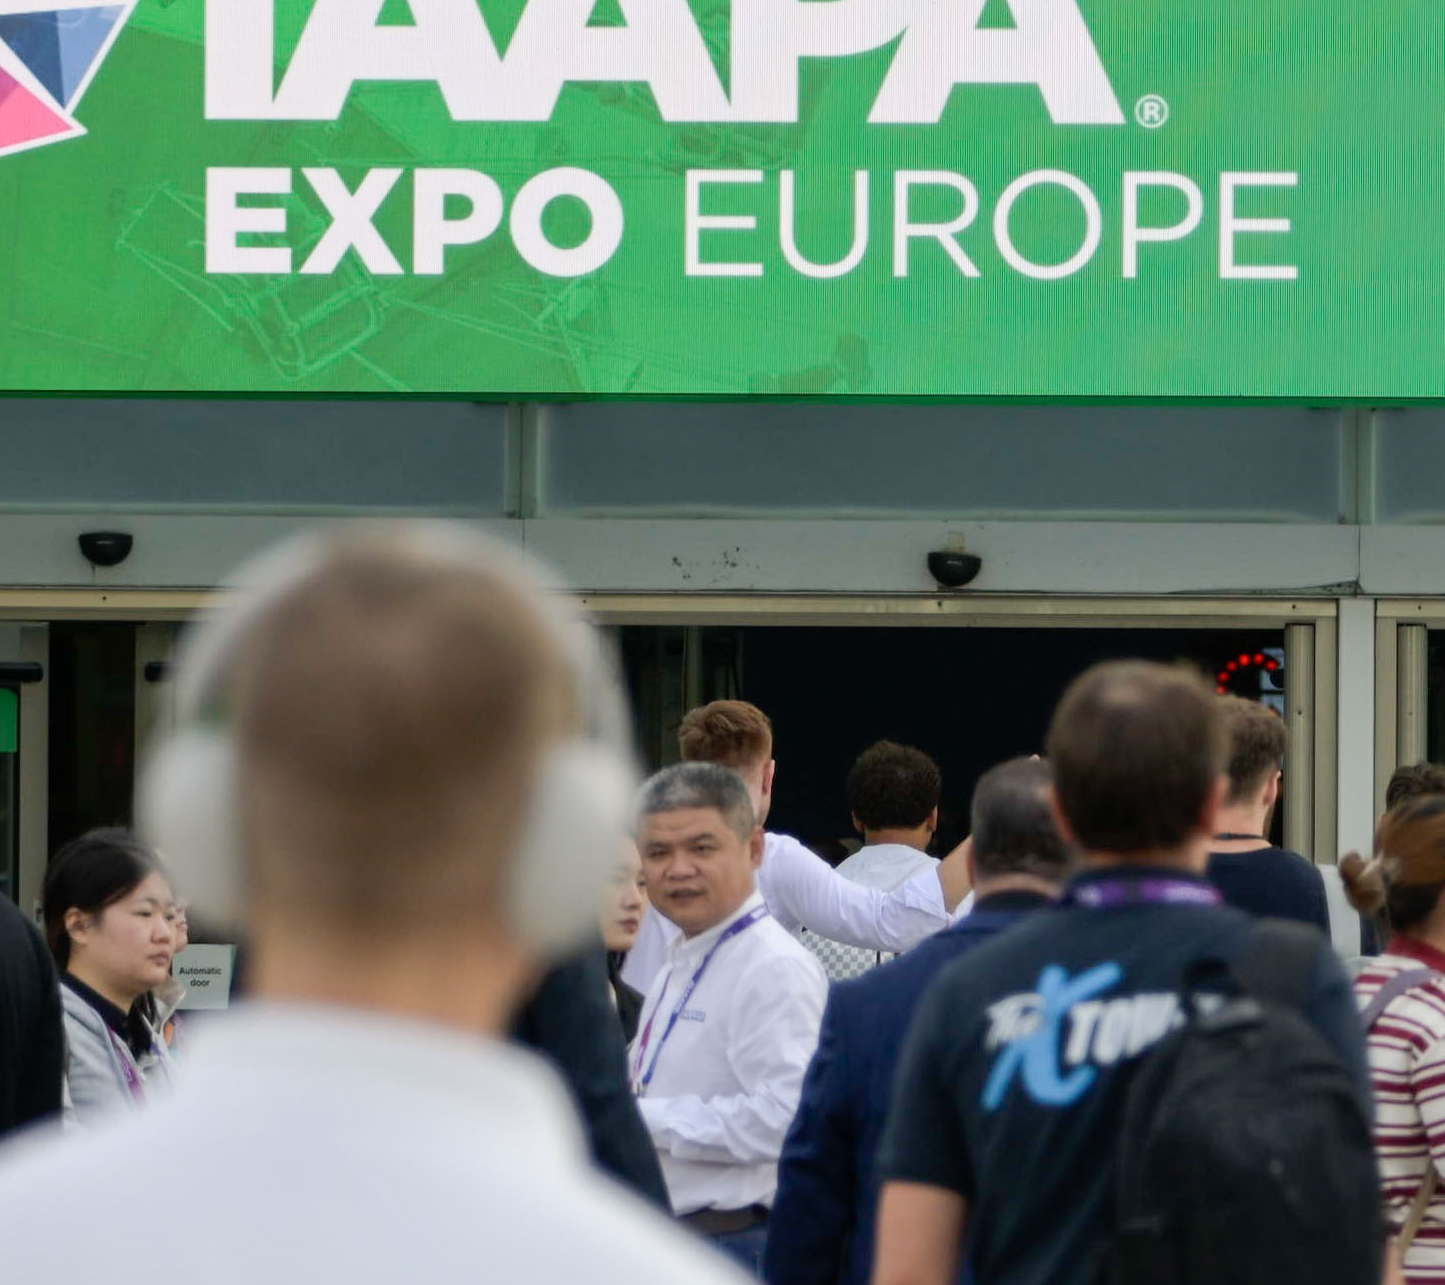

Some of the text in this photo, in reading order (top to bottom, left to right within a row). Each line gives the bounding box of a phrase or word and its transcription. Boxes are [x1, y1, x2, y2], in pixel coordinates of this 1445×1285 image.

[205, 167, 1298, 280] EXPO EUROPE
[178, 966, 223, 976] Automatic
[189, 978, 211, 988] door
